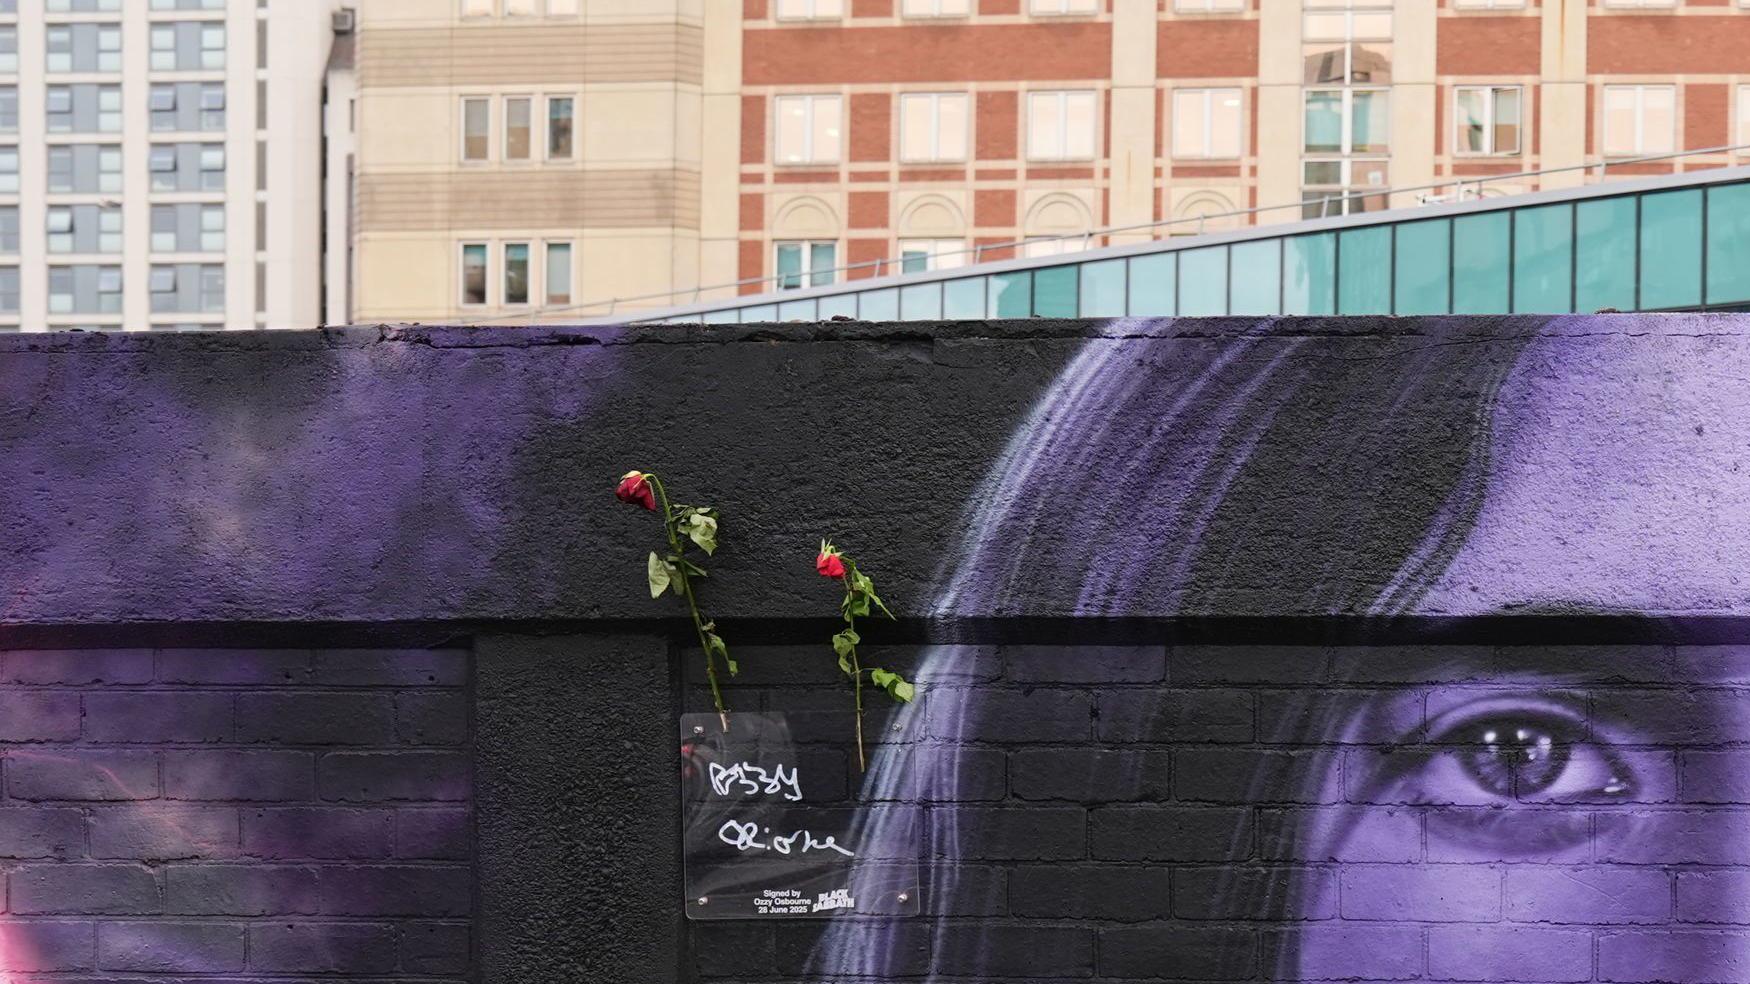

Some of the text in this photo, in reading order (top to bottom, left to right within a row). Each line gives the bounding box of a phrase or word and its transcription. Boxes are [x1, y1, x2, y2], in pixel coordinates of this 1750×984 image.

[763, 889, 801, 899] Signed by
[818, 889, 848, 902] BLACK
[753, 897, 812, 907] Ozzy Osbourne
[758, 906, 808, 914] 28 June 2025
